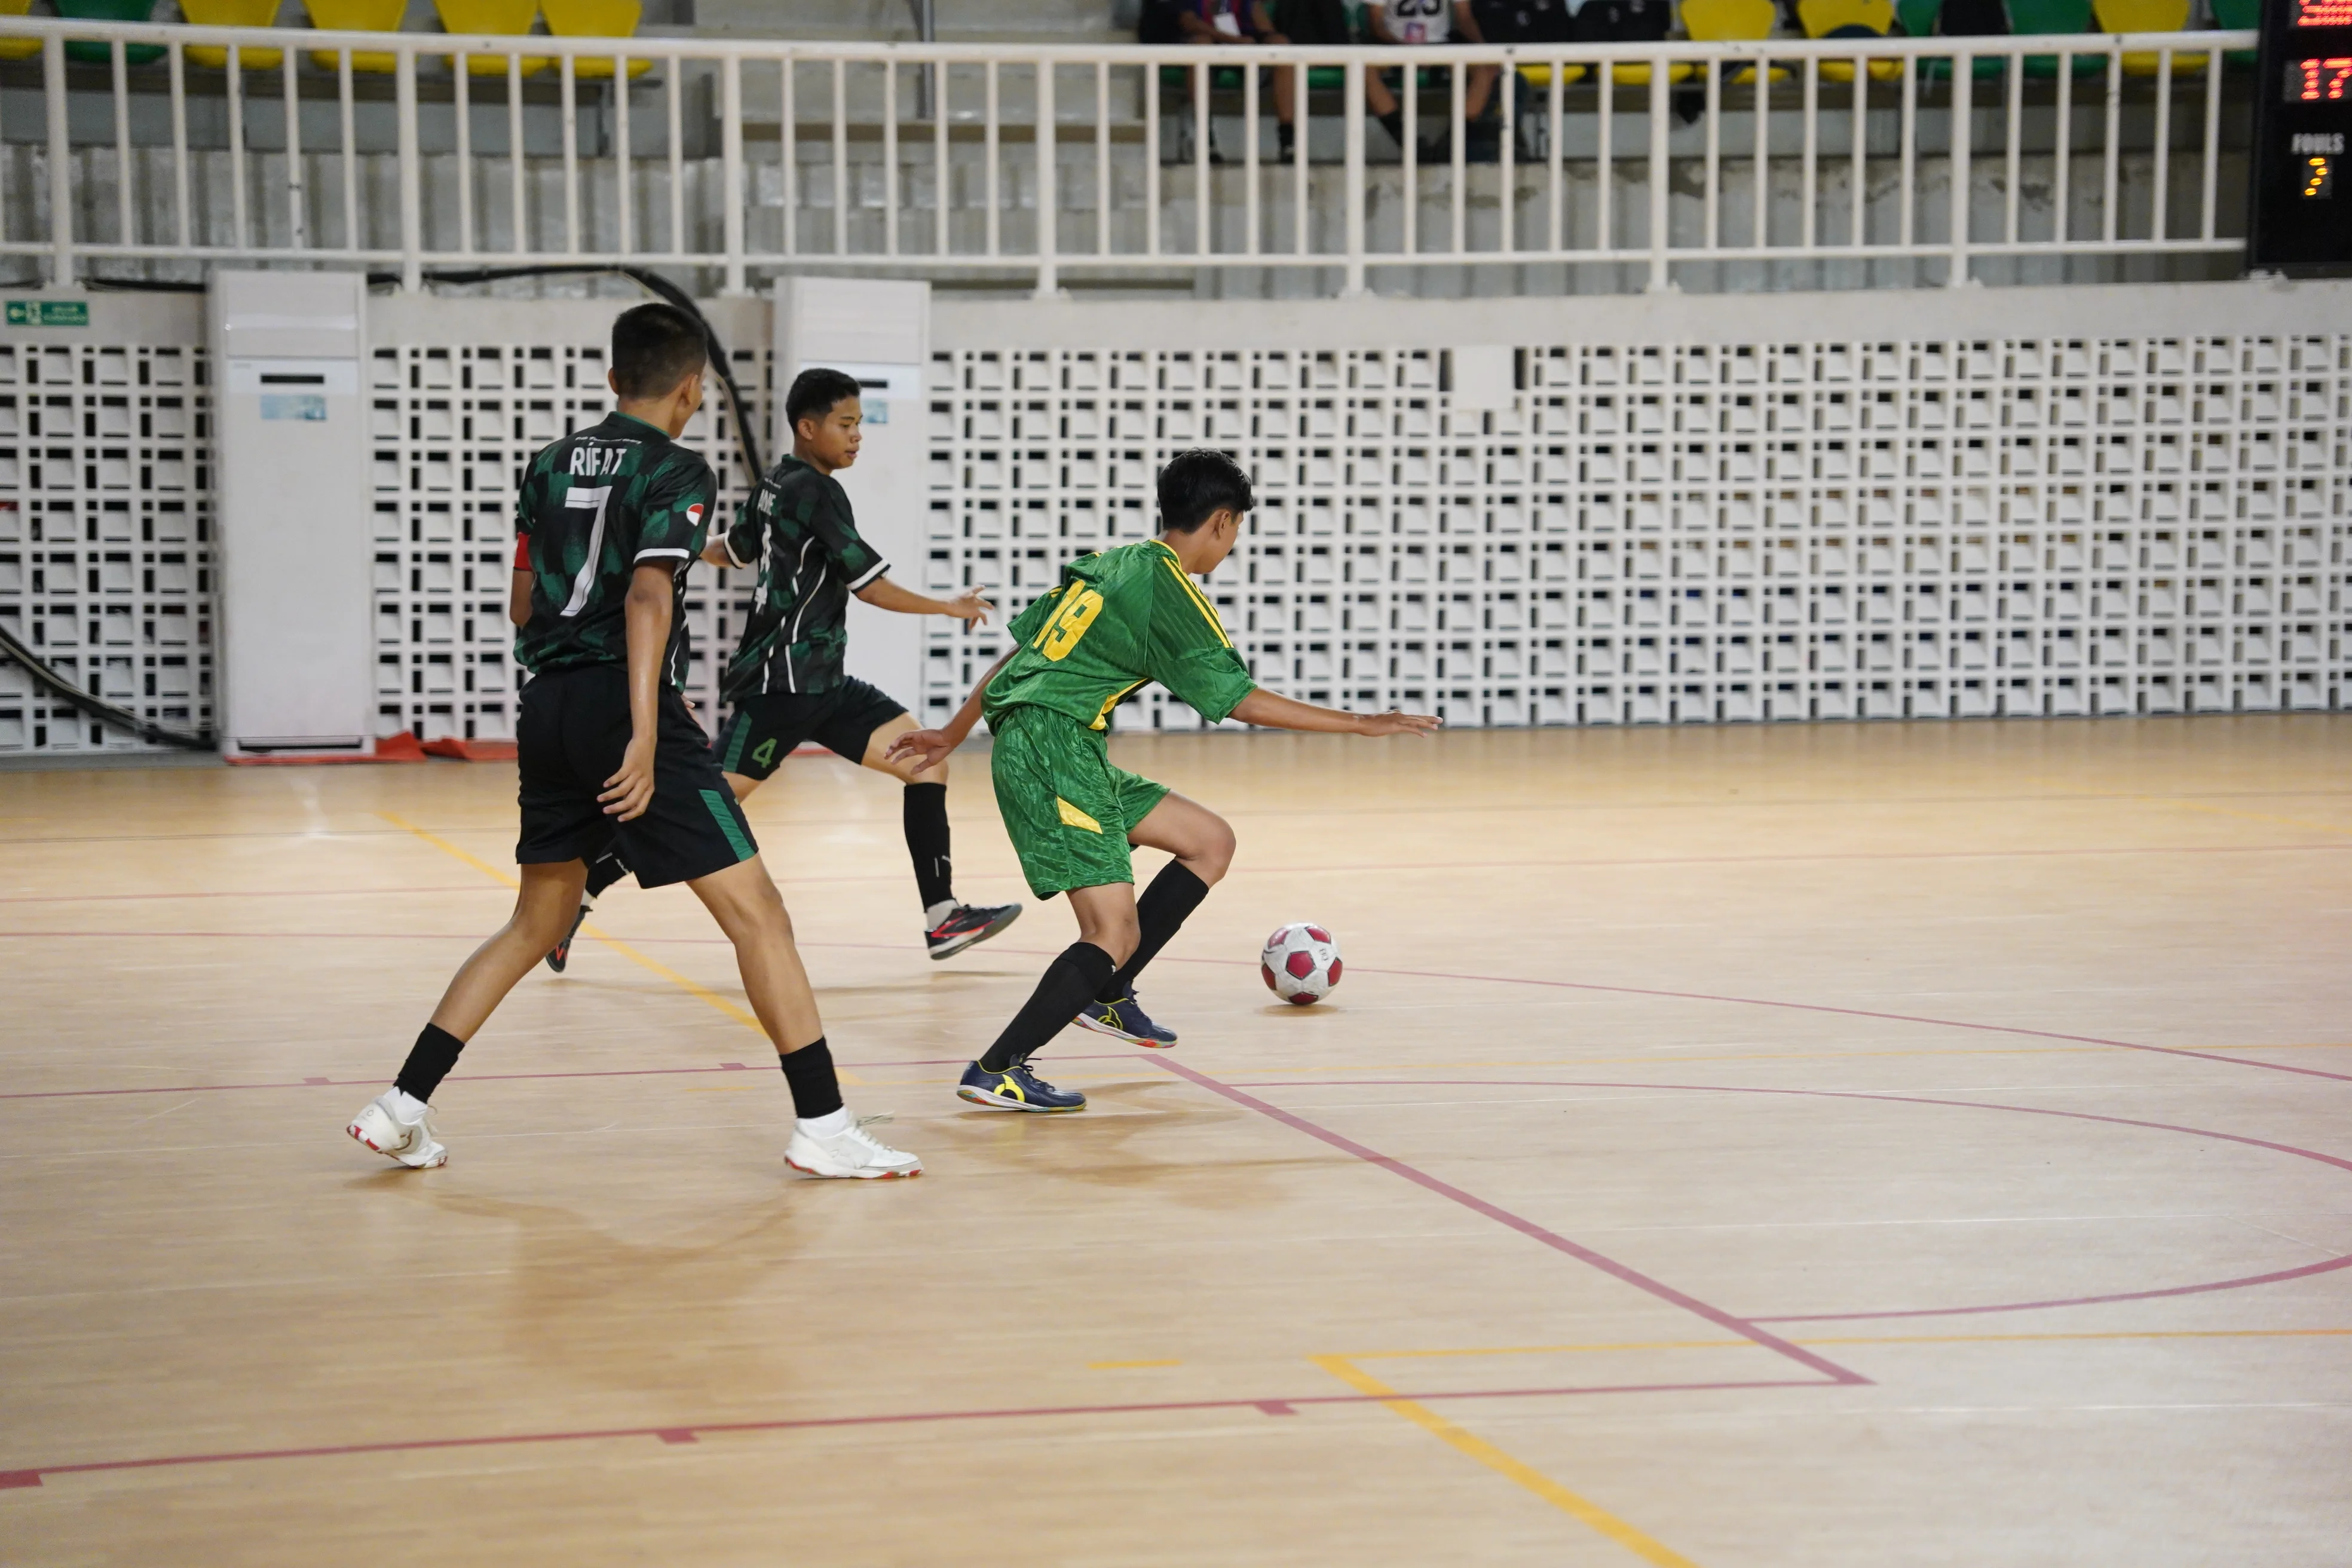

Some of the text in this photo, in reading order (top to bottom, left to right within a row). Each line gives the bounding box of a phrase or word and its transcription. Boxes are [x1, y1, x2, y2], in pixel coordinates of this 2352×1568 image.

[559, 486, 612, 617] 7
[1032, 579, 1104, 662] 19
[752, 737, 777, 768] 4
